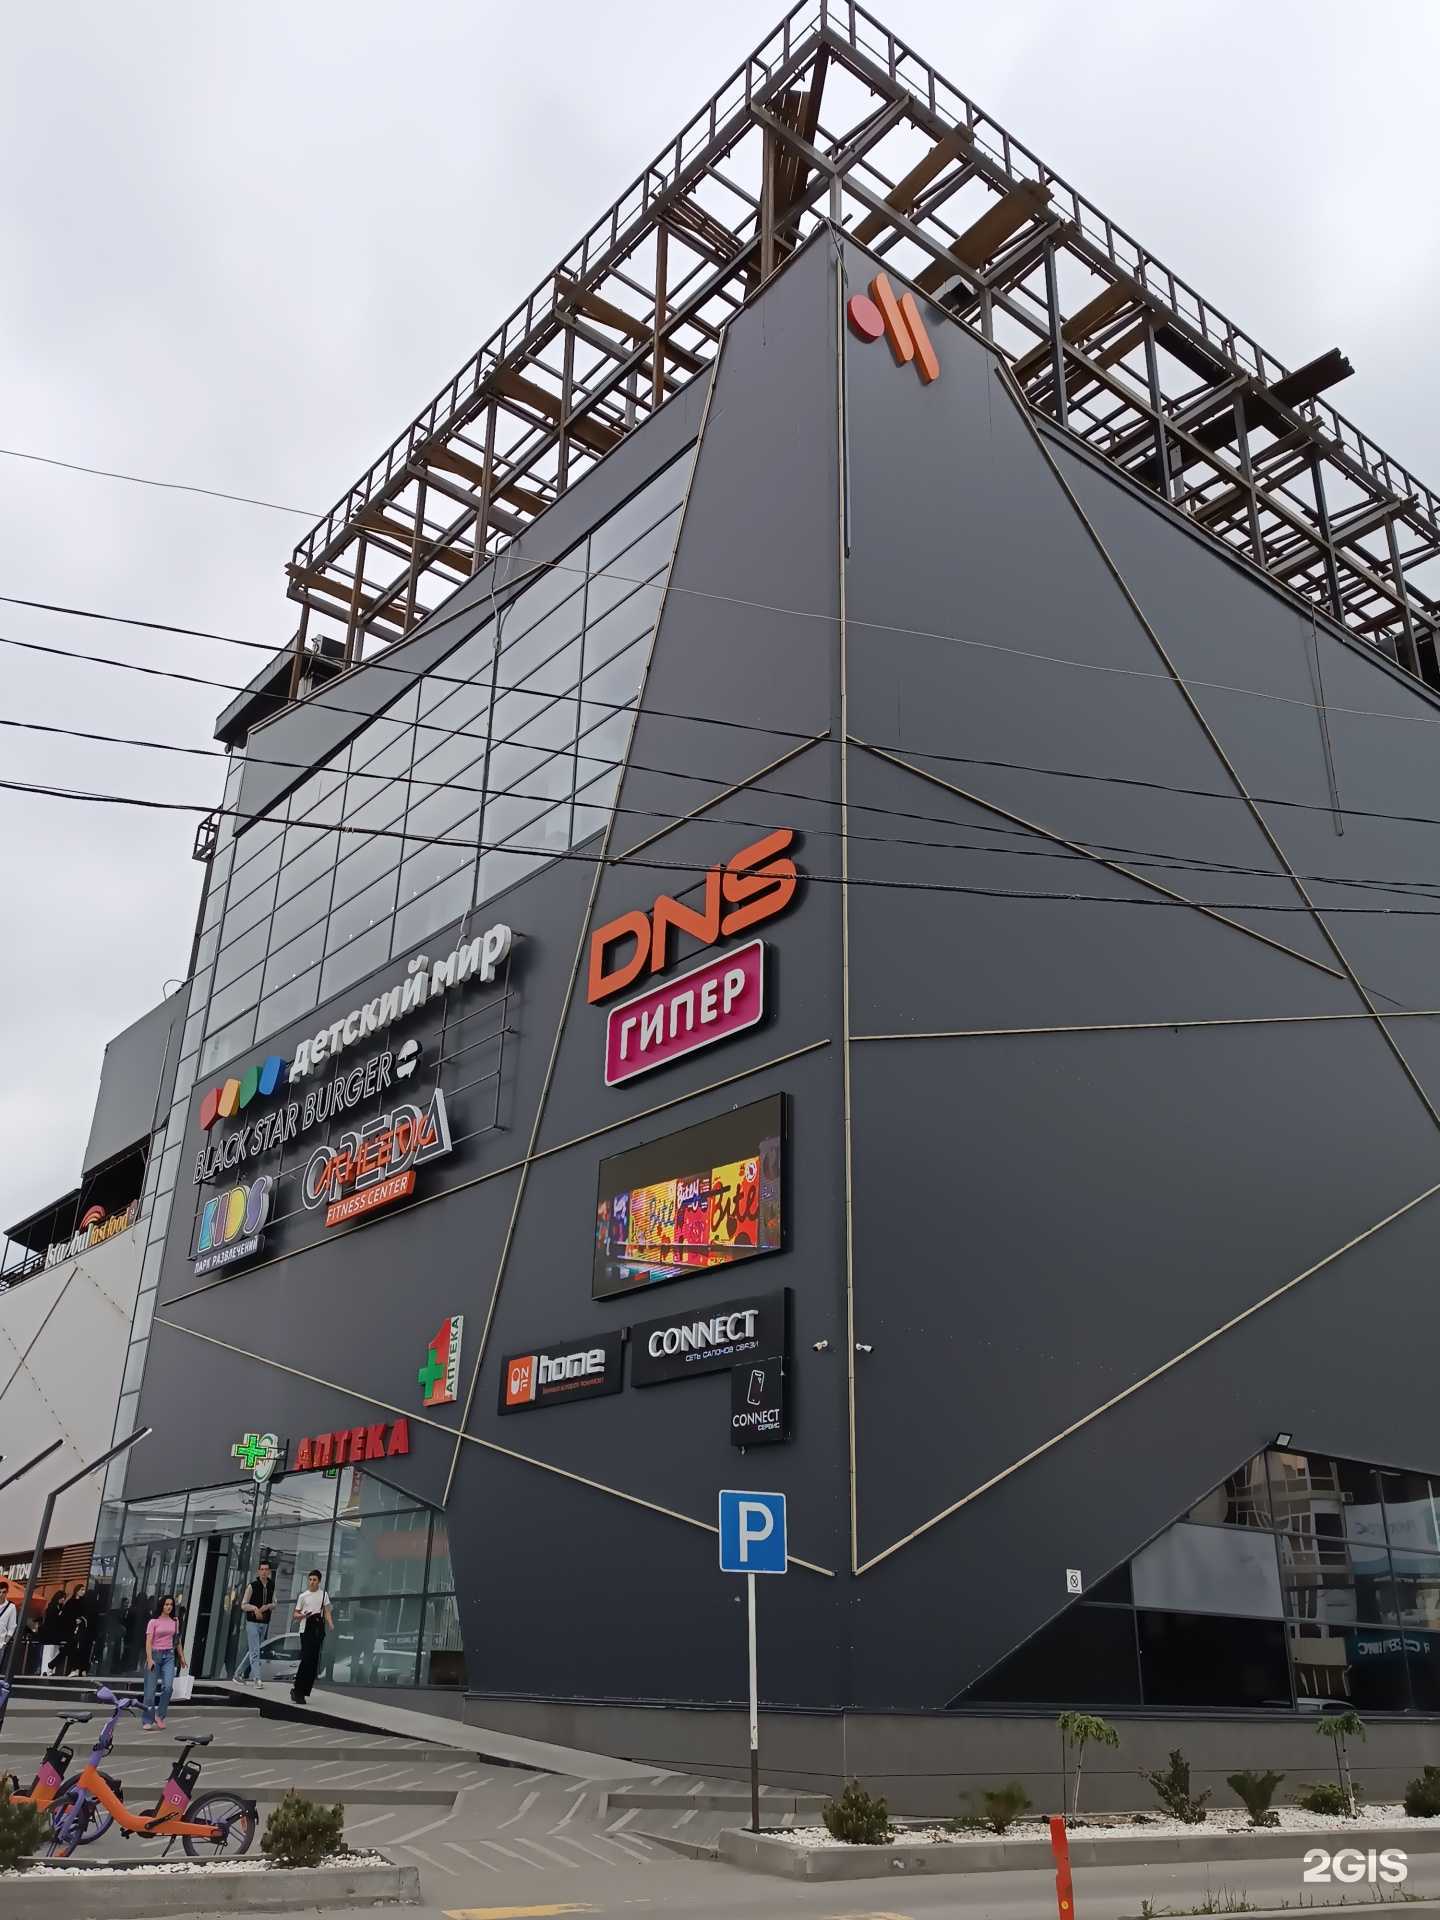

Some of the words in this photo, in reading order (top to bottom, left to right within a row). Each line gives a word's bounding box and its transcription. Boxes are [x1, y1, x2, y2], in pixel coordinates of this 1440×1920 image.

[587, 826, 797, 1003] DNS
[620, 968, 746, 1061] ГИПЕР
[193, 1126, 251, 1185] BLACK
[250, 1103, 300, 1156] STAR
[302, 1051, 395, 1131] BURGER
[327, 1193, 368, 1219] FITNESS
[367, 1176, 408, 1203] CENTER
[193, 1256, 212, 1274] ПАРК
[445, 1316, 460, 1393] АПТЕКА
[649, 1310, 759, 1358] CONNECT
[538, 1349, 606, 1384] home
[732, 1408, 780, 1427] CONNECT
[294, 1418, 410, 1471] АПТЕКА
[738, 1501, 774, 1562] P
